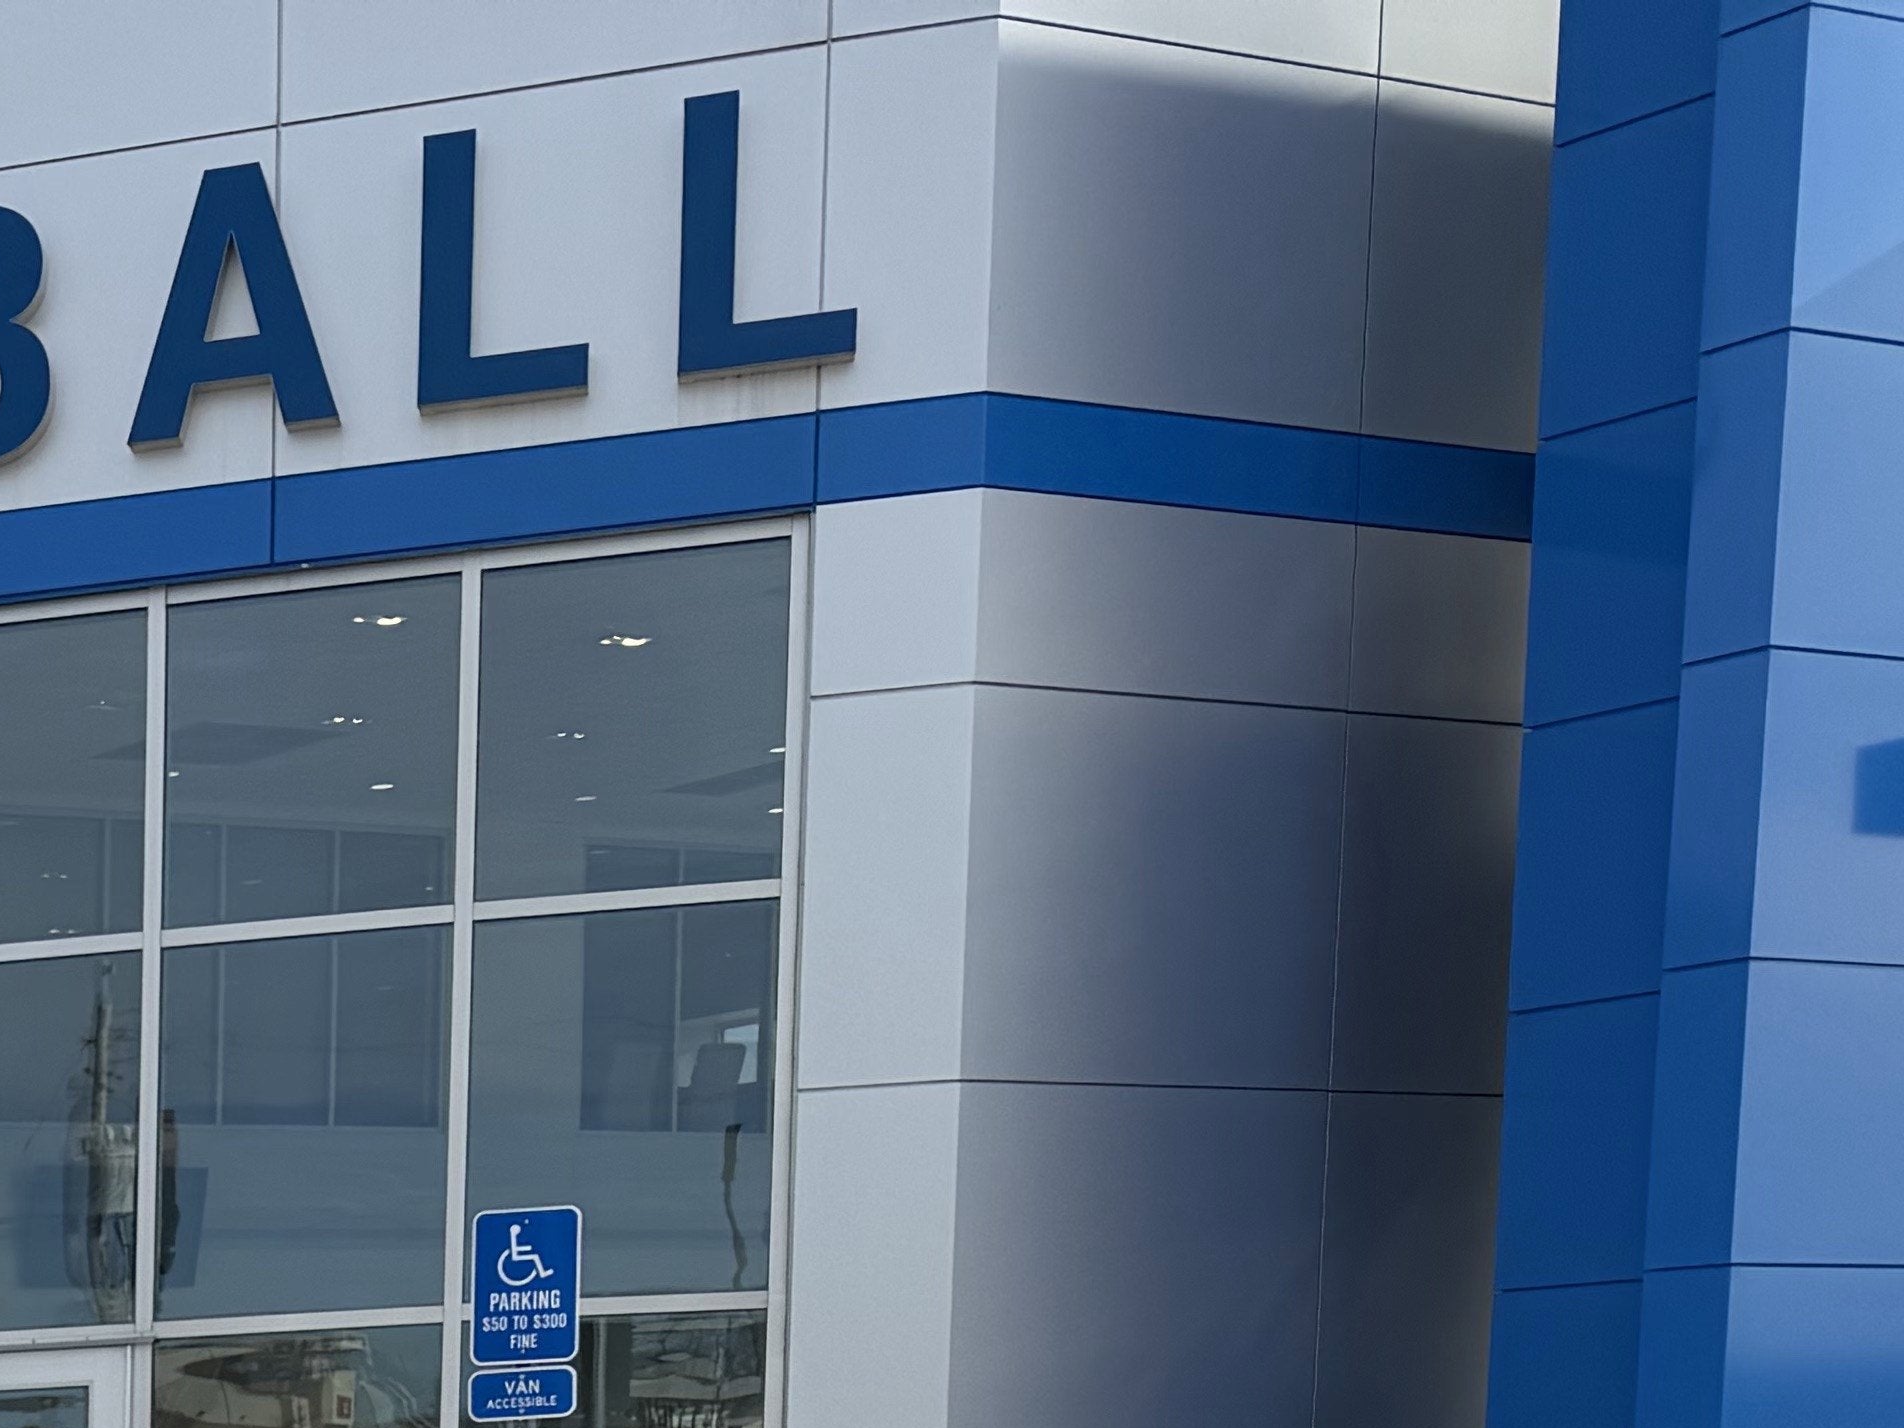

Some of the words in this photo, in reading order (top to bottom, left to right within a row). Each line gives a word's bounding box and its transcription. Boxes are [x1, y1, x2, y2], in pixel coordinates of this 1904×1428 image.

[489, 1289, 561, 1312] PARKING
[482, 1315, 508, 1332] $50
[513, 1314, 528, 1331] TO
[533, 1313, 567, 1330] $300
[510, 1333, 538, 1350] FINE
[504, 1379, 541, 1395] VAN
[486, 1395, 558, 1409] ACCESSIBLE
